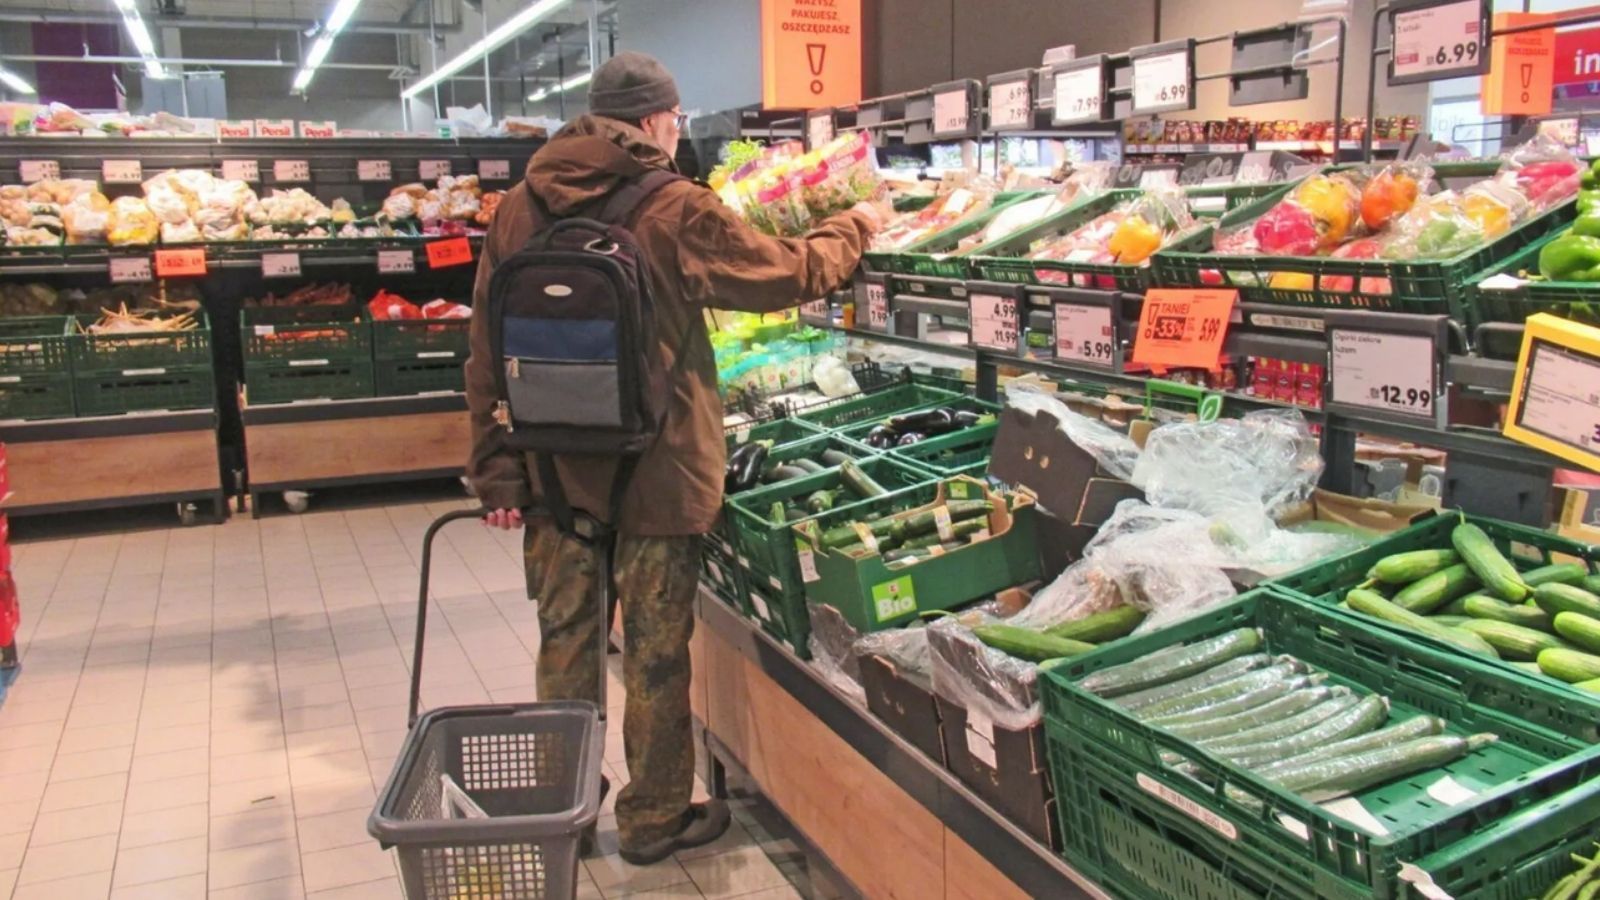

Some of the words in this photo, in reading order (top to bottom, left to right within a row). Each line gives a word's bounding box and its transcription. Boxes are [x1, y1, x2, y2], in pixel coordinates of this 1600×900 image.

[1436, 41, 1477, 65] 6.99
[1160, 84, 1186, 101] 6.99
[1077, 98, 1099, 112] 7.99
[220, 127, 249, 136] Persil
[261, 126, 290, 136] Persil
[305, 127, 333, 137] Persil
[994, 303, 1015, 318] 4.99
[994, 330, 1017, 344] 11.99
[1083, 340, 1111, 359] 5.99
[1380, 385, 1430, 408] 12.99
[879, 595, 913, 618] Bio
